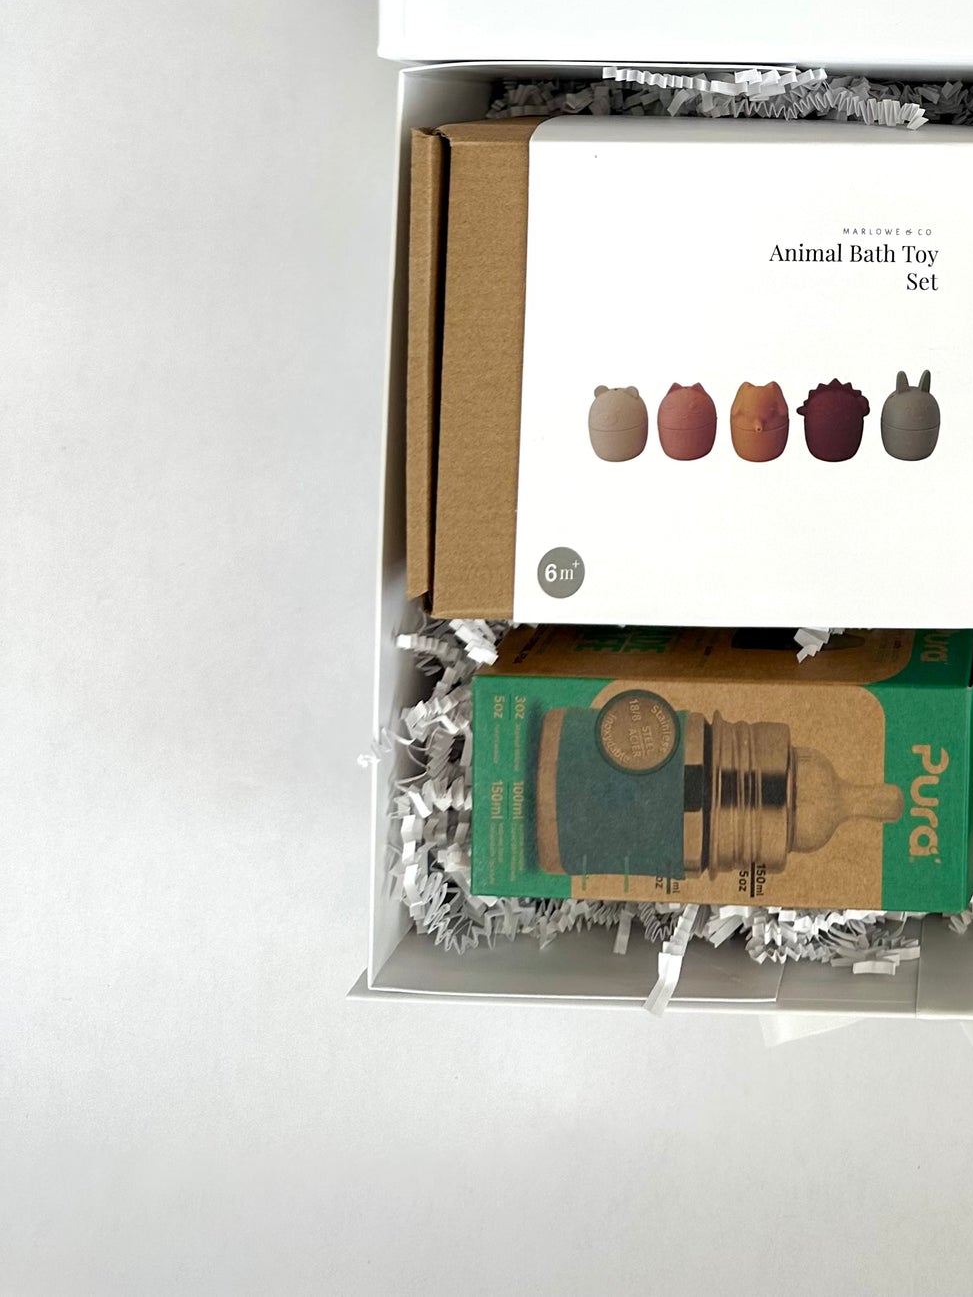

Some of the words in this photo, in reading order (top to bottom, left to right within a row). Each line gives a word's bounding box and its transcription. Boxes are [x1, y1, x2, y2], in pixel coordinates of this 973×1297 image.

[842, 228, 901, 236] MARLOWE
[917, 228, 933, 236] CO
[769, 243, 843, 263] Animal
[849, 243, 896, 263] Bath
[901, 245, 939, 267] Toy
[906, 272, 939, 291] Set
[628, 698, 642, 722] 18/8
[491, 780, 504, 820] 150ml
[512, 780, 525, 820] 100ml
